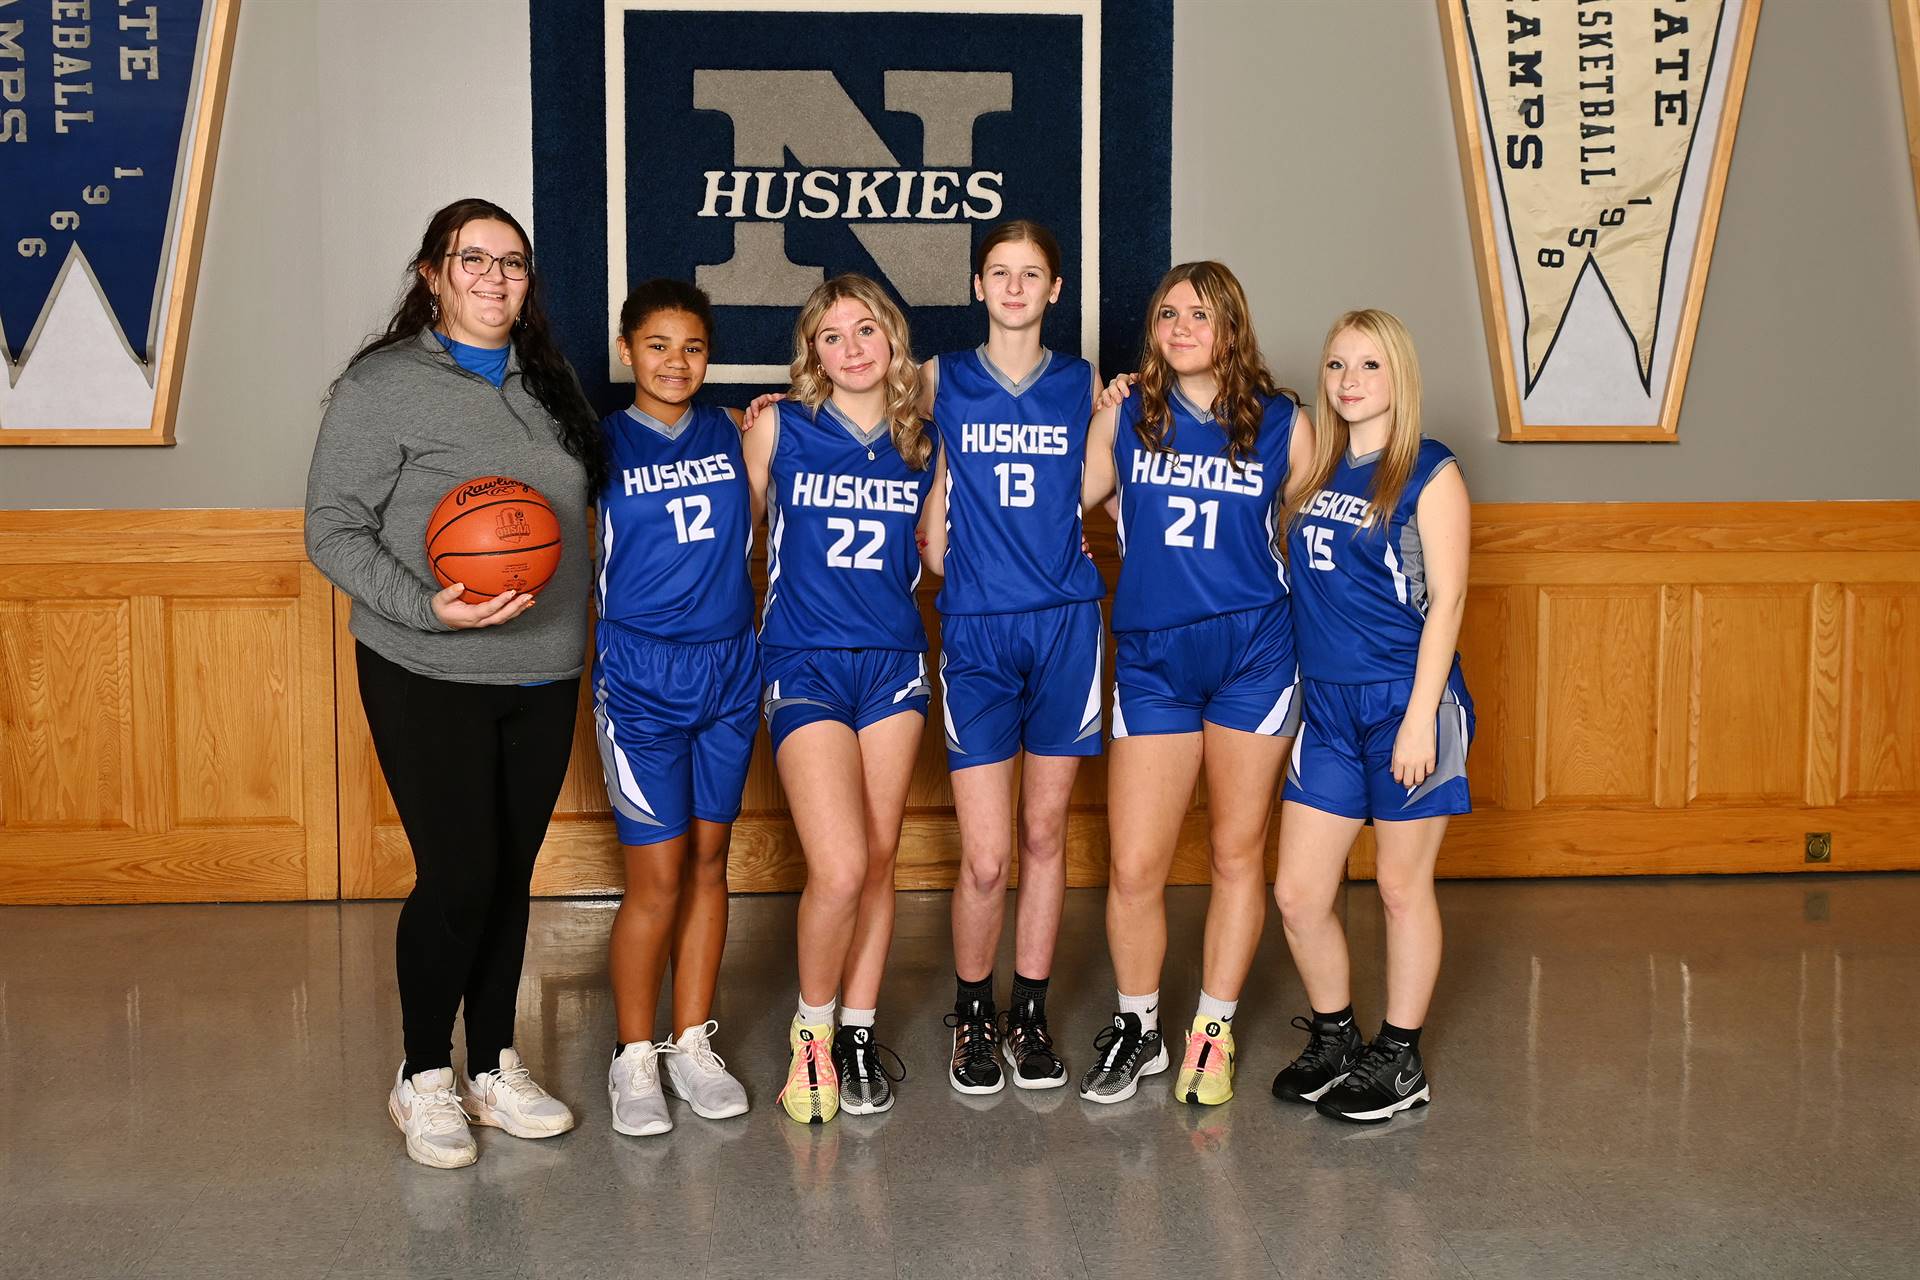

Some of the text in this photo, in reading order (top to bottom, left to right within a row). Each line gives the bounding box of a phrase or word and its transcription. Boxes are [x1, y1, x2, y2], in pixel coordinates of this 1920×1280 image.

[119, 0, 159, 80] TE
[1654, 0, 1689, 126] ATE
[0, 0, 27, 142] MPS
[52, 0, 94, 133] EBALL
[1506, 0, 1544, 170] AMPS
[1578, 0, 1616, 185] SKETBALL
[697, 170, 1003, 219] HUSKIES
[961, 423, 1069, 455] HUSKIES
[456, 478, 537, 505] Rawling
[622, 453, 737, 497] HUSKIES
[791, 472, 919, 514] HUSKIES
[993, 462, 1035, 508] 13
[1131, 448, 1264, 497] HUSKIES
[664, 494, 716, 545] 12
[1164, 495, 1220, 549] 21
[1298, 490, 1374, 528] USKIES
[826, 516, 886, 571] 22
[1302, 524, 1336, 571] 15
